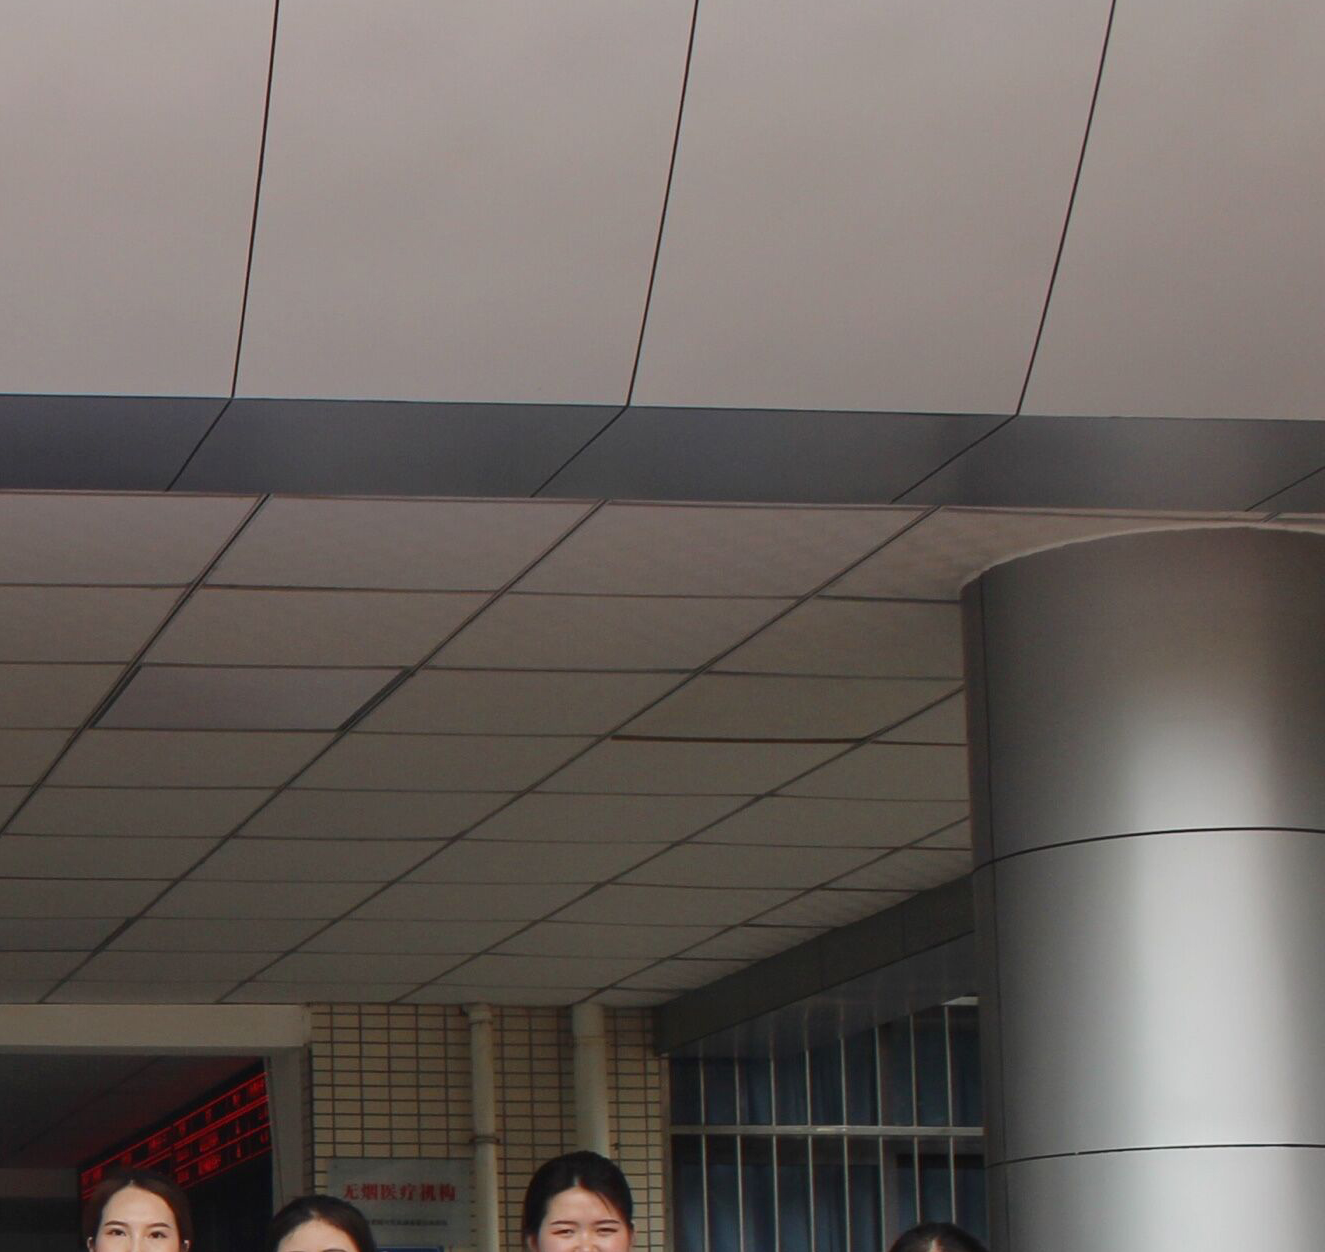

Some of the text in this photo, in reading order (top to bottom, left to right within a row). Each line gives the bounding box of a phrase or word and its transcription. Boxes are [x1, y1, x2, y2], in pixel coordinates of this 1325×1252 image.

[344, 1183, 456, 1202] 无烟医疗机构
